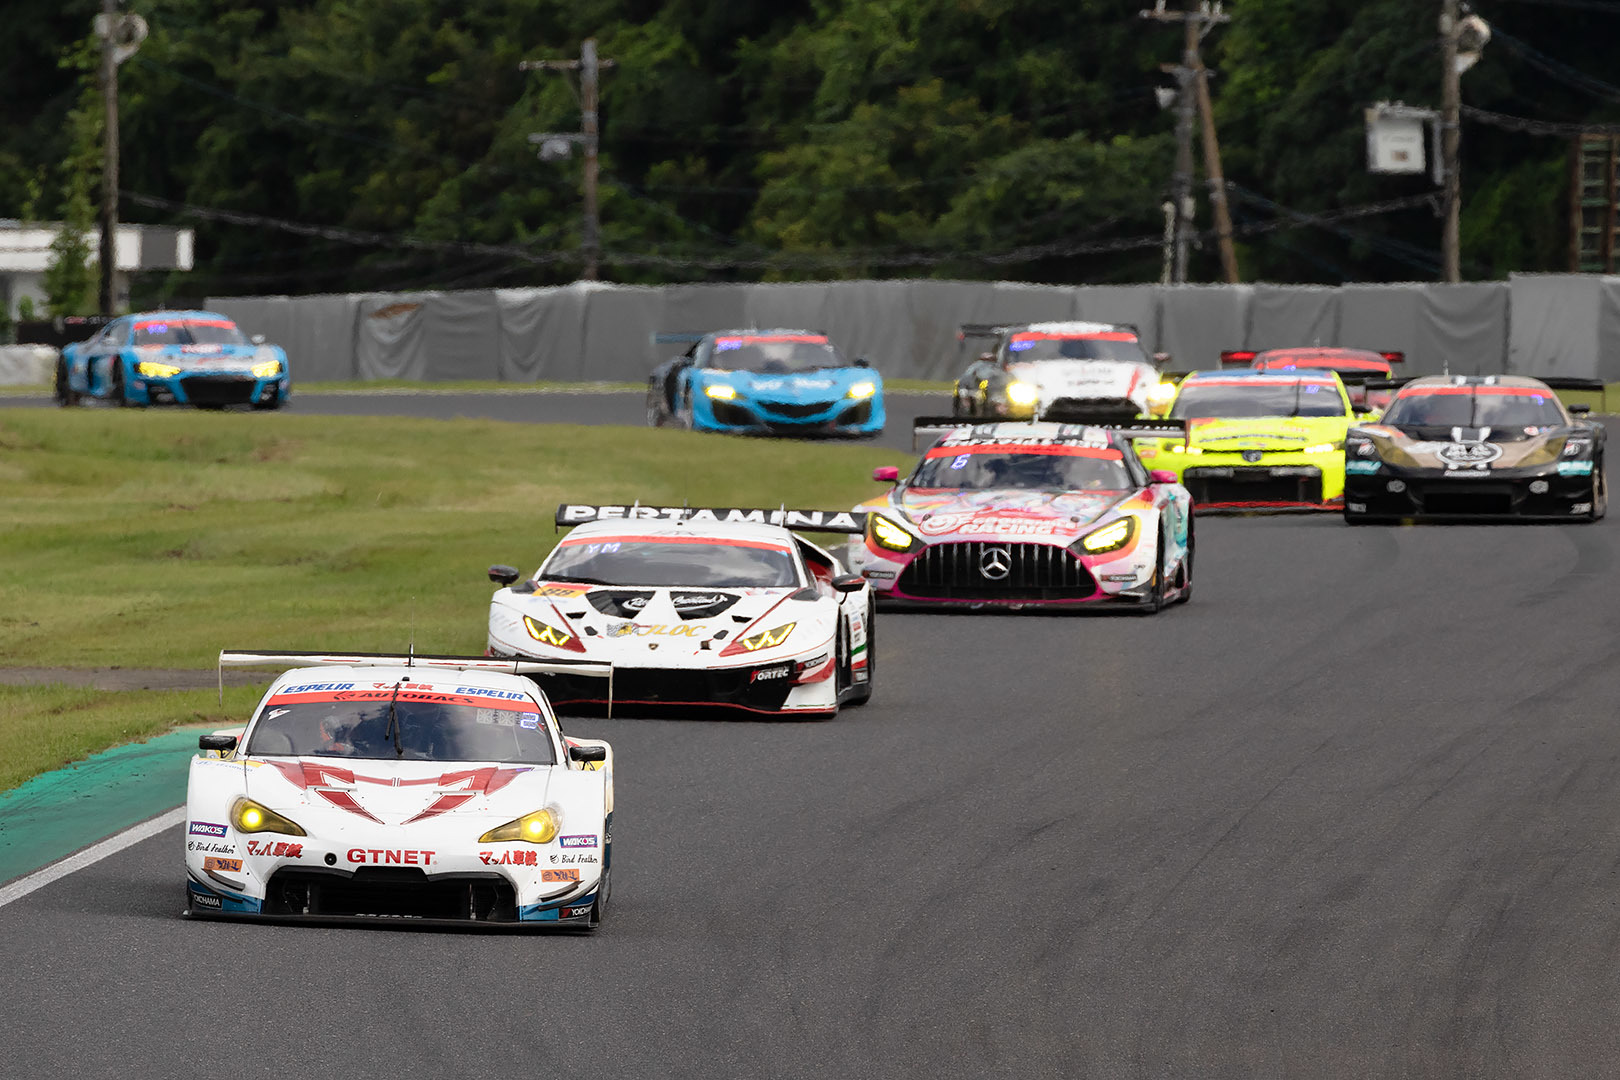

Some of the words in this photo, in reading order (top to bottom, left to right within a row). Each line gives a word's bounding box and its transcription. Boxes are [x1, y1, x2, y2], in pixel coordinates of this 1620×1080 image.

[564, 505, 858, 527] PERTAMINA
[638, 624, 706, 637] JLOC
[283, 683, 355, 694] ESPELIR
[456, 687, 525, 700] ESPELIR
[346, 848, 436, 865] GTNET
